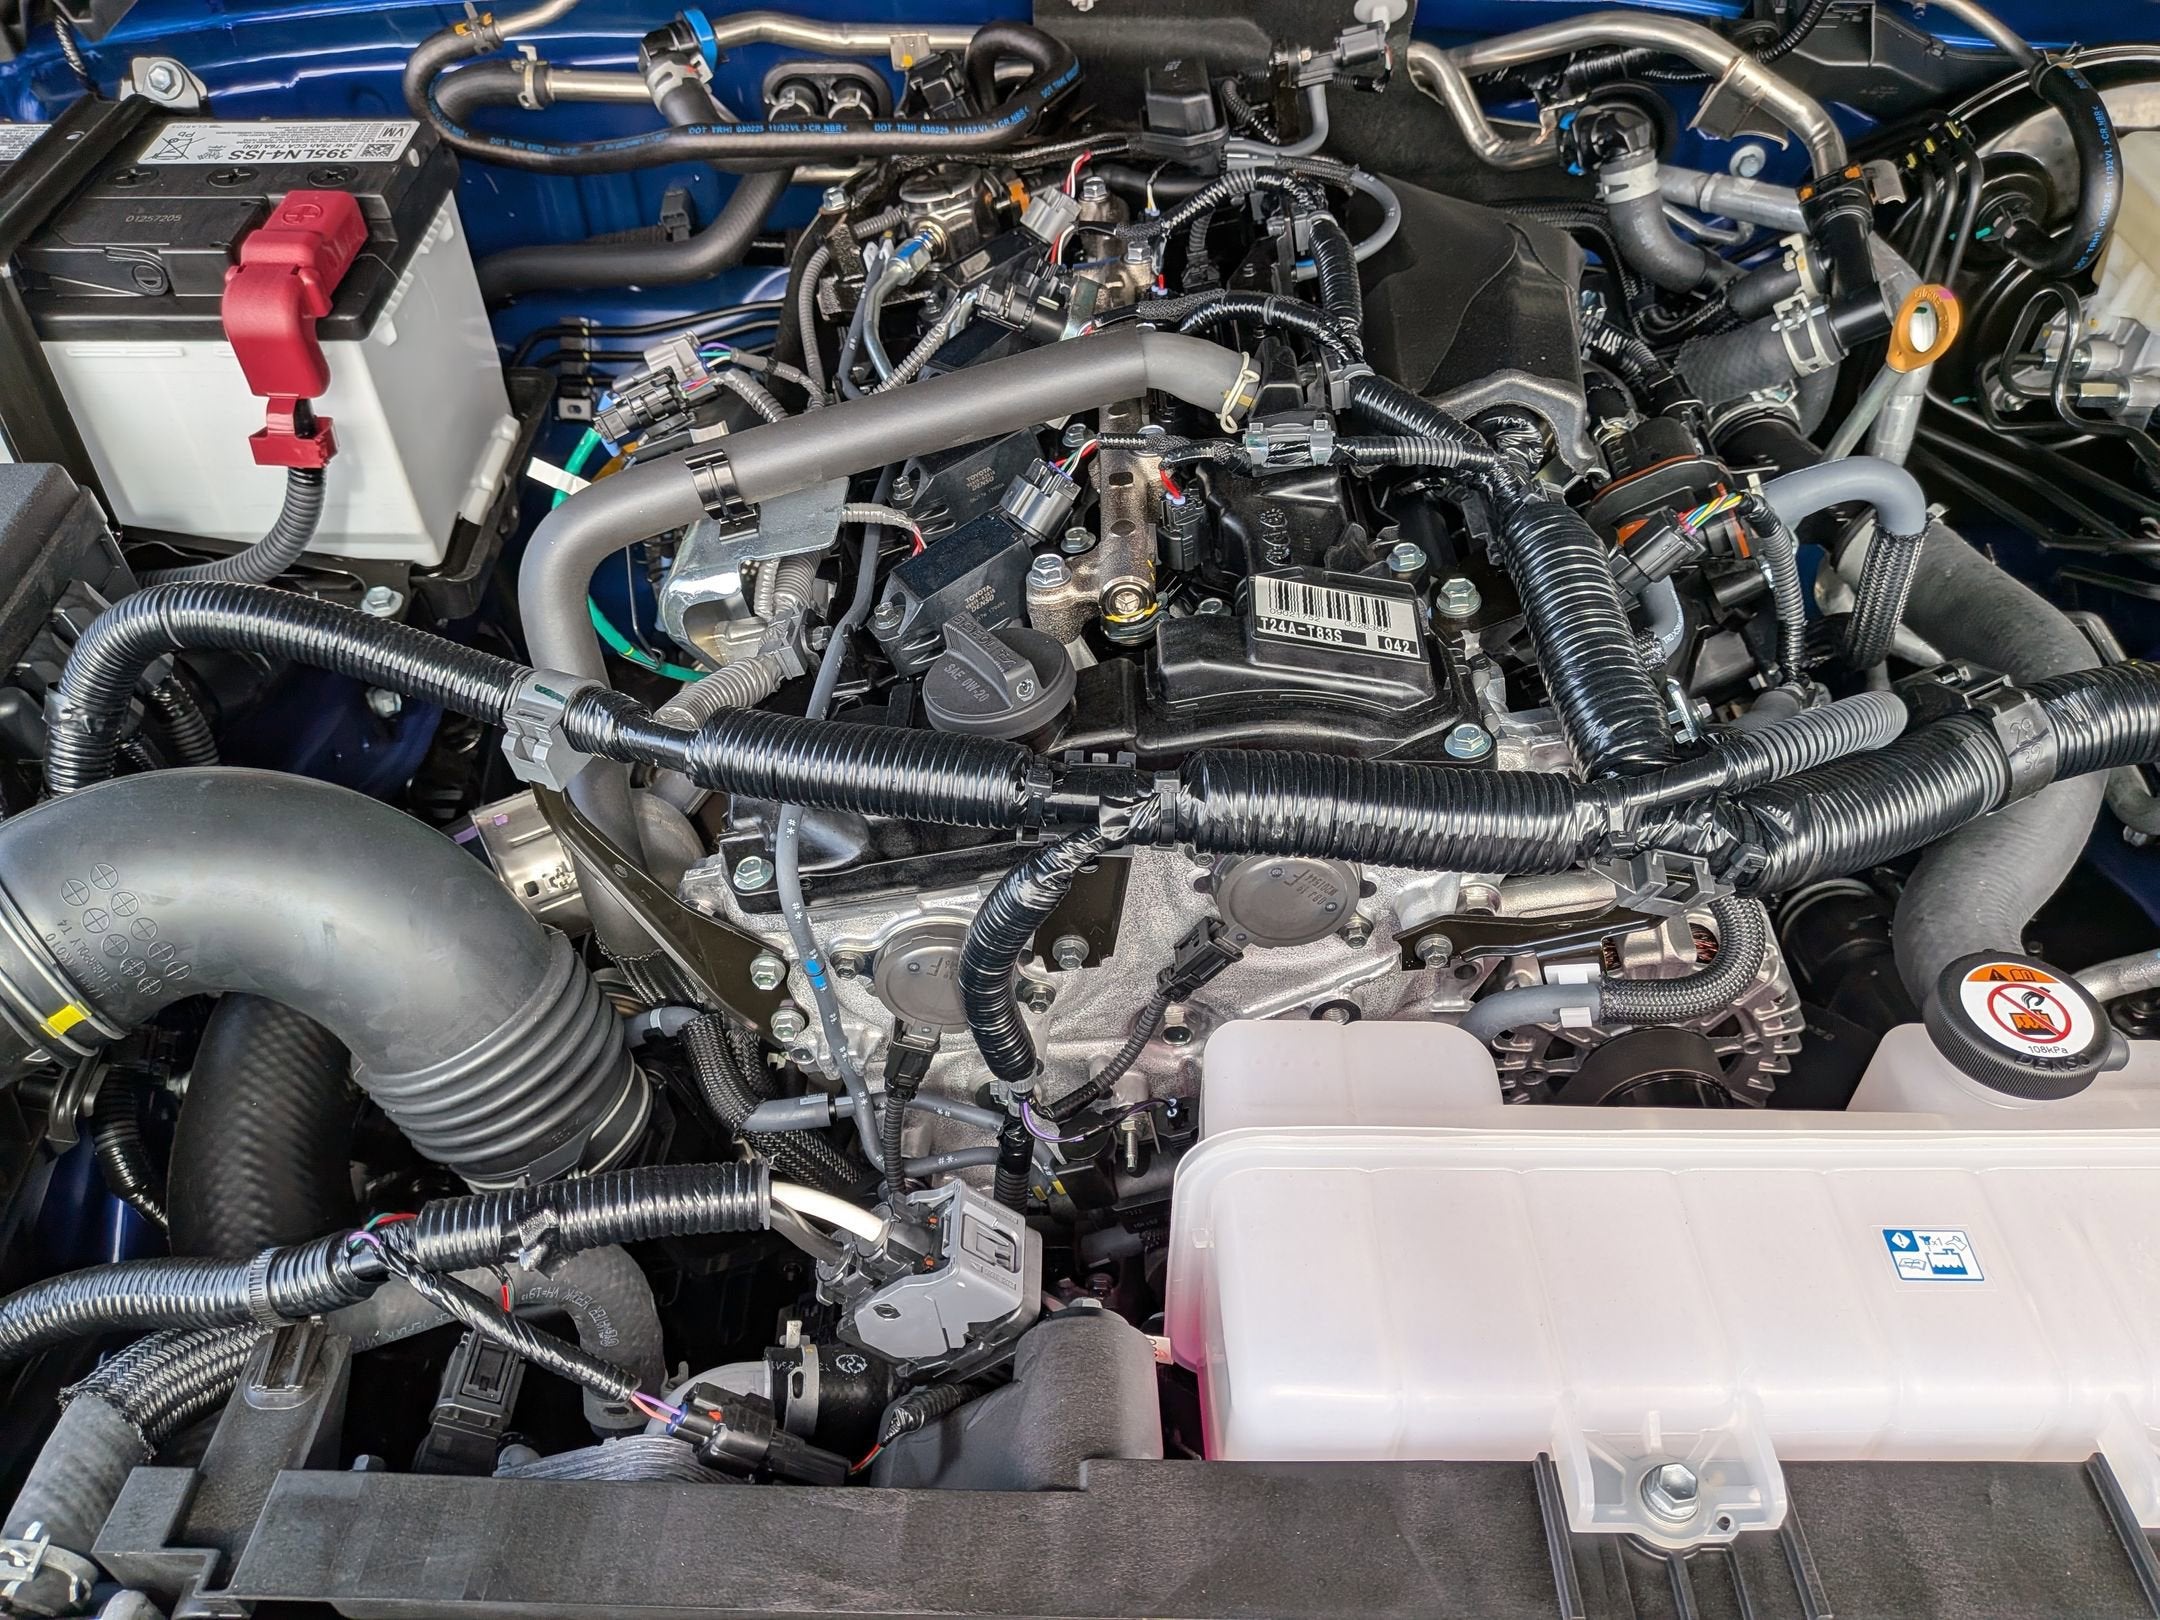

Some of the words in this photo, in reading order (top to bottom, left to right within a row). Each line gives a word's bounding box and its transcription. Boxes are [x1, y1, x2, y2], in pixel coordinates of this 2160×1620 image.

[382, 127, 405, 137] VM
[688, 127, 707, 135] DOT
[874, 123, 892, 132] DOT
[227, 148, 353, 160] 395LN4-ISS
[965, 466, 993, 482] TOYOTA
[971, 475, 995, 491] DENSO
[965, 584, 992, 603] TOYOTA
[971, 594, 995, 613] DENSO
[1260, 616, 1343, 643] T24A-T83S
[1384, 637, 1410, 653] 042
[944, 663, 965, 682] SAE
[2027, 1045, 2069, 1055] 108kPa
[2014, 1053, 2091, 1073] DENSO
